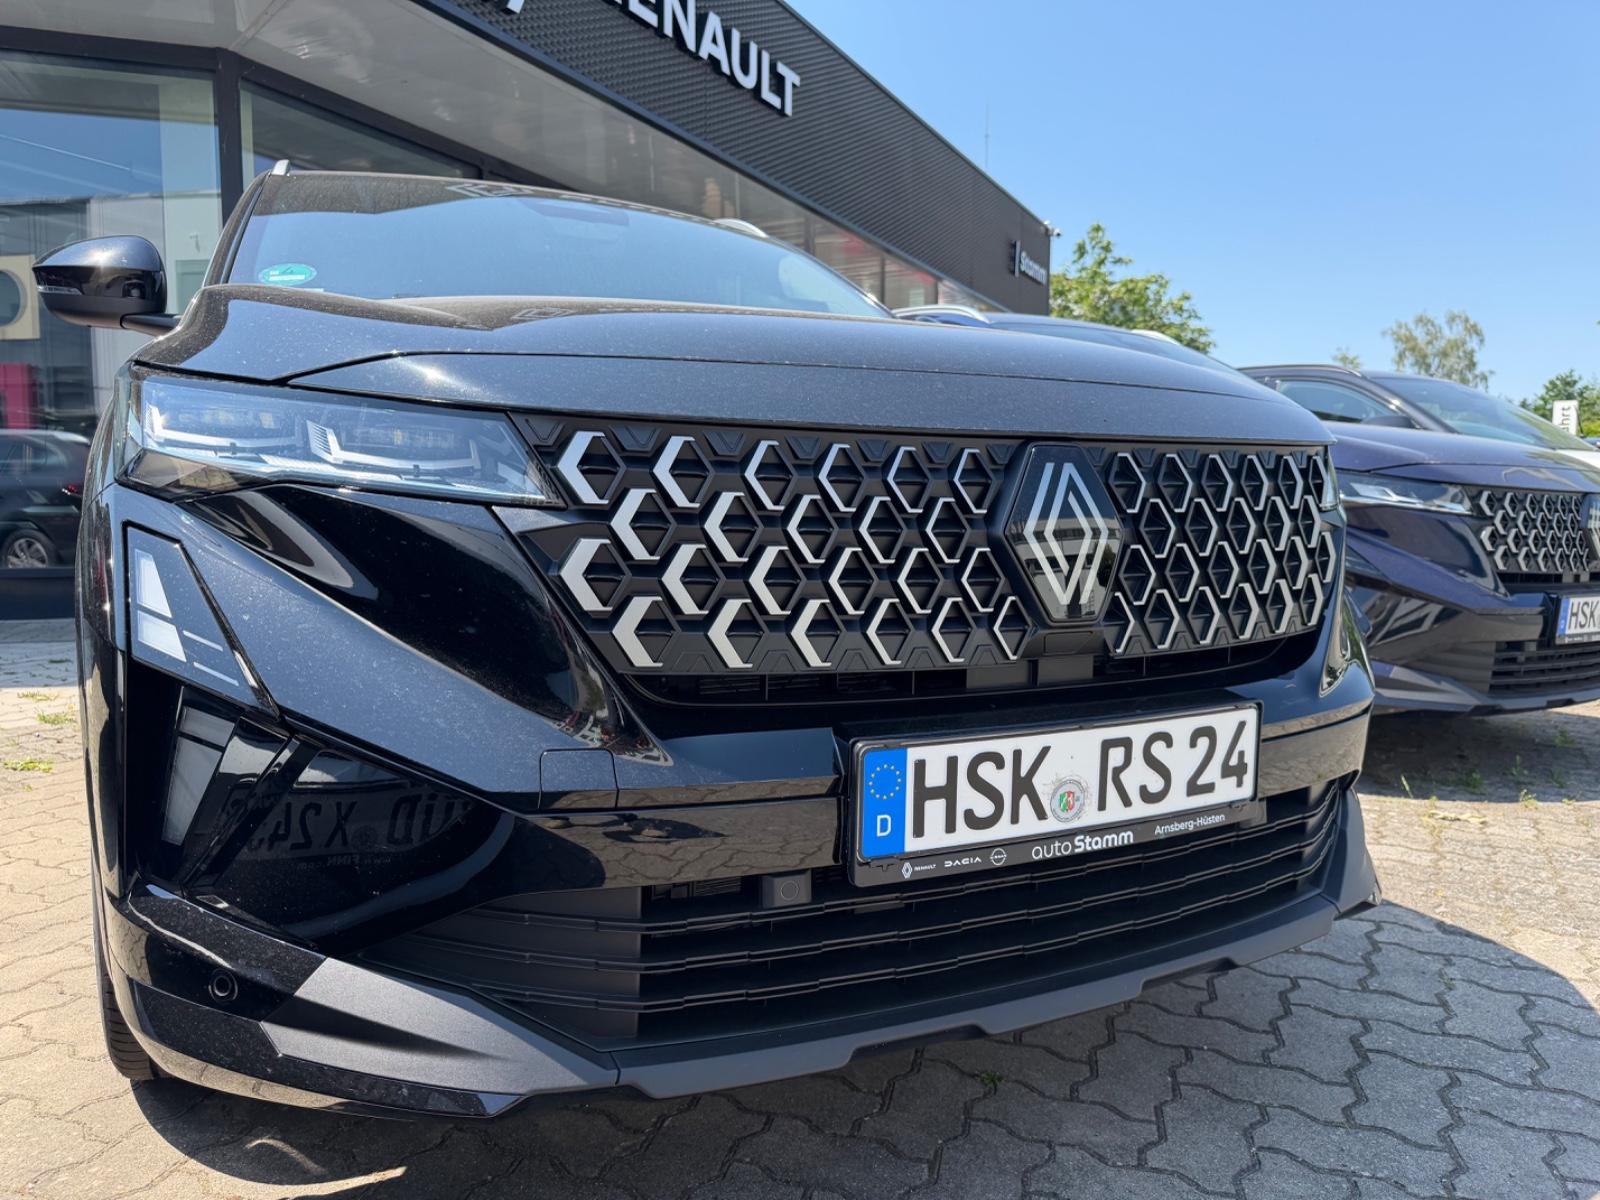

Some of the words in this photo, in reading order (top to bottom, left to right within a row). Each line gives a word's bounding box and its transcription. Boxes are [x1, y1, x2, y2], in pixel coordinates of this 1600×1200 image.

[613, 0, 800, 117] NAULT
[1568, 601, 1599, 630] HSK
[912, 745, 1051, 839] HSK
[1097, 732, 1174, 812] RS
[1185, 720, 1249, 798] 24
[876, 814, 892, 838] D
[1154, 813, 1226, 836] Arnsberg-Hüsten
[1031, 839, 1072, 861] auto
[1074, 830, 1134, 853] Stamm
[944, 856, 982, 867] DACIA
